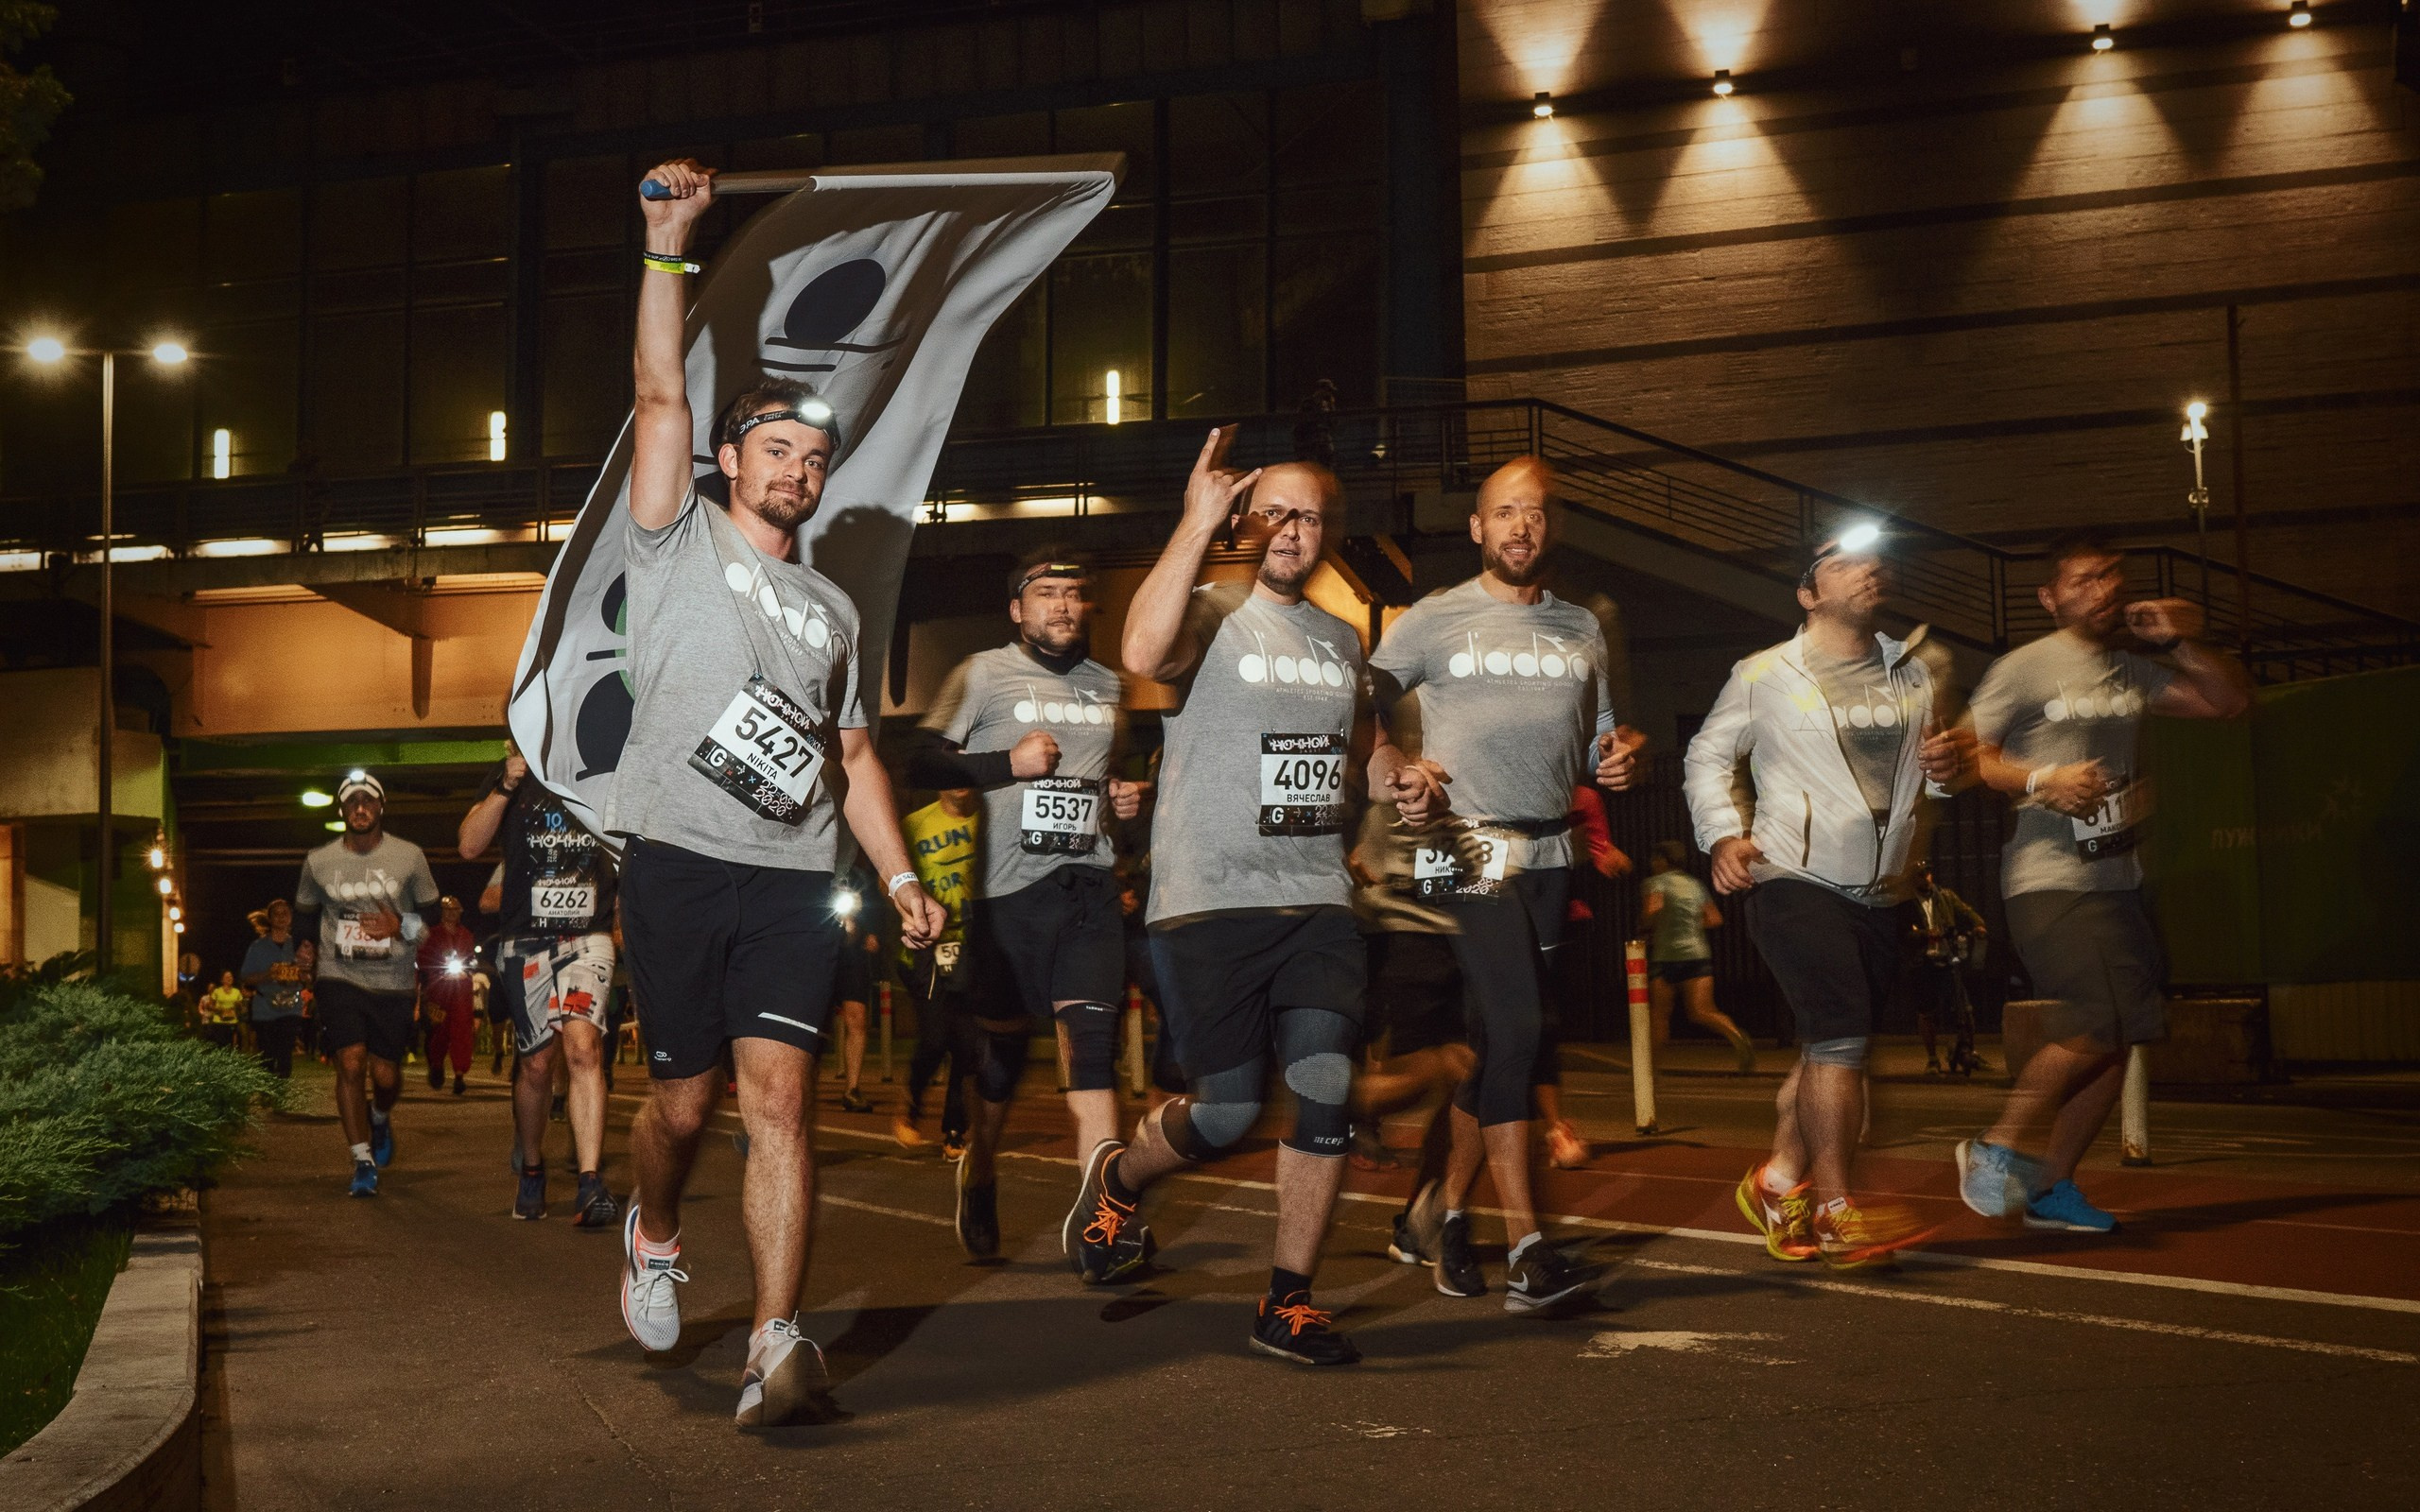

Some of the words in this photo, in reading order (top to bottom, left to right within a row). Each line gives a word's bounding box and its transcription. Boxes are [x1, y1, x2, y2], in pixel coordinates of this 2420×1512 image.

[739, 417, 760, 435] ЭРА
[735, 706, 814, 779] 5427
[710, 747, 728, 767] G
[747, 752, 778, 781] NIKITA
[1273, 759, 1341, 790] 4096
[752, 788, 786, 816] 2020
[1287, 793, 1331, 802] ВЯЧЕСЛАВ
[1035, 795, 1093, 822] 5537
[1271, 806, 1285, 824] G
[544, 813, 562, 829] 10
[1052, 822, 1077, 831] ИГОРЬ
[917, 825, 972, 857] RUN
[1031, 831, 1043, 845] G
[2087, 839, 2098, 852] G
[1423, 879, 1432, 895] G
[540, 890, 588, 908] 6262
[539, 918, 547, 927] H
